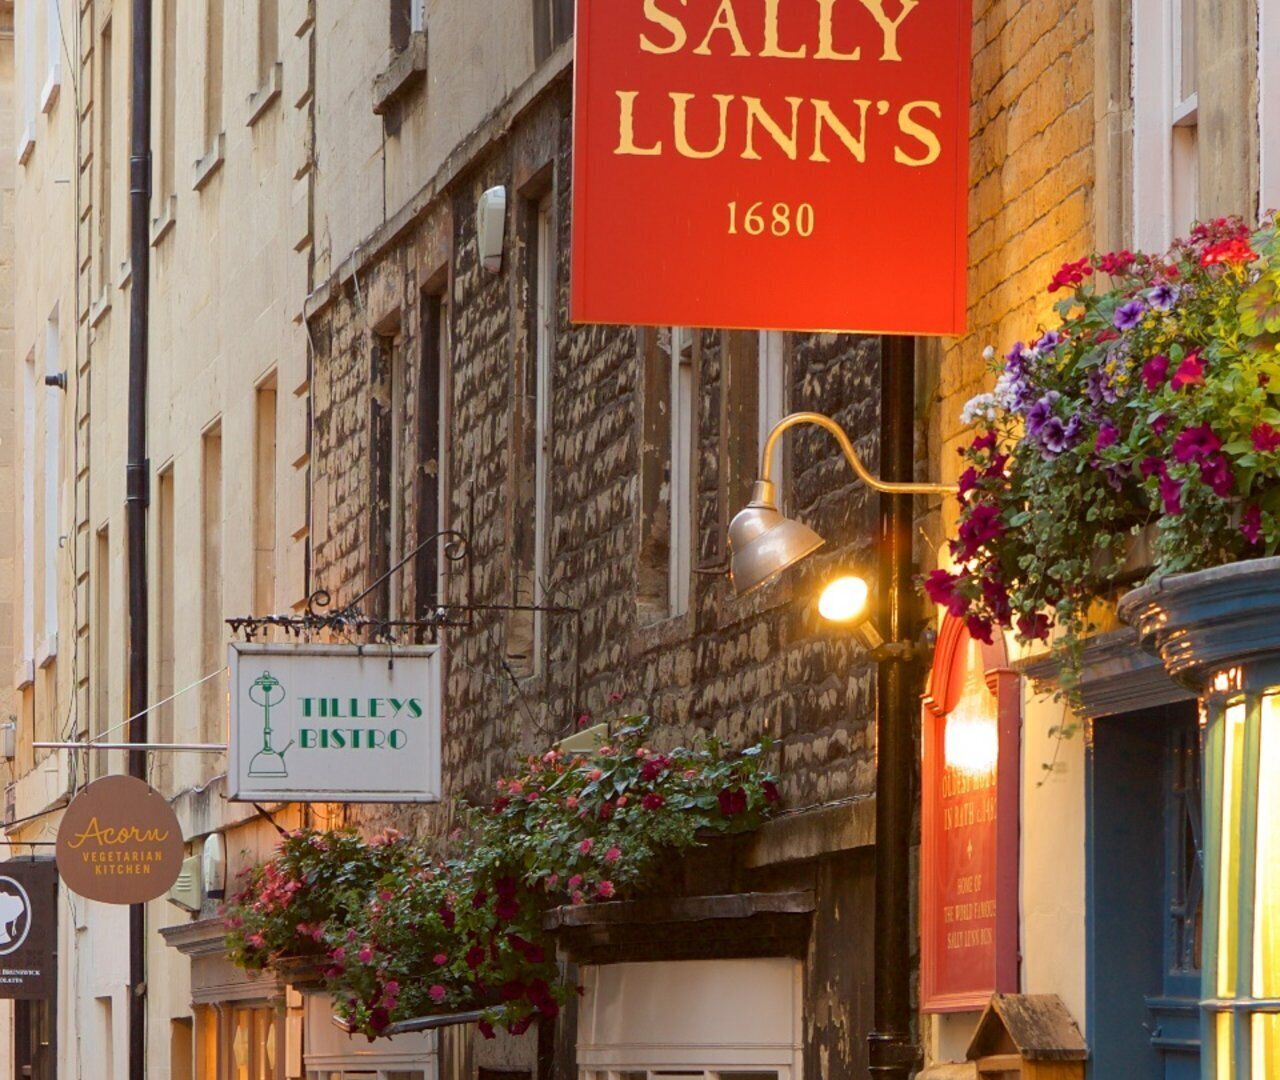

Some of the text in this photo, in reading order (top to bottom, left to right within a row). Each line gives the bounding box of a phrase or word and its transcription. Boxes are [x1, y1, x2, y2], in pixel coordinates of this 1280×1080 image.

[639, 0, 919, 62] SALLY
[614, 90, 942, 167] LUNN'S
[727, 201, 815, 237] 1680
[298, 697, 423, 718] TILLEYS
[298, 728, 408, 750] BISTRO
[67, 817, 169, 849] Acorn
[82, 850, 163, 863] VEGETARIAN
[95, 864, 152, 875] KITCHEN
